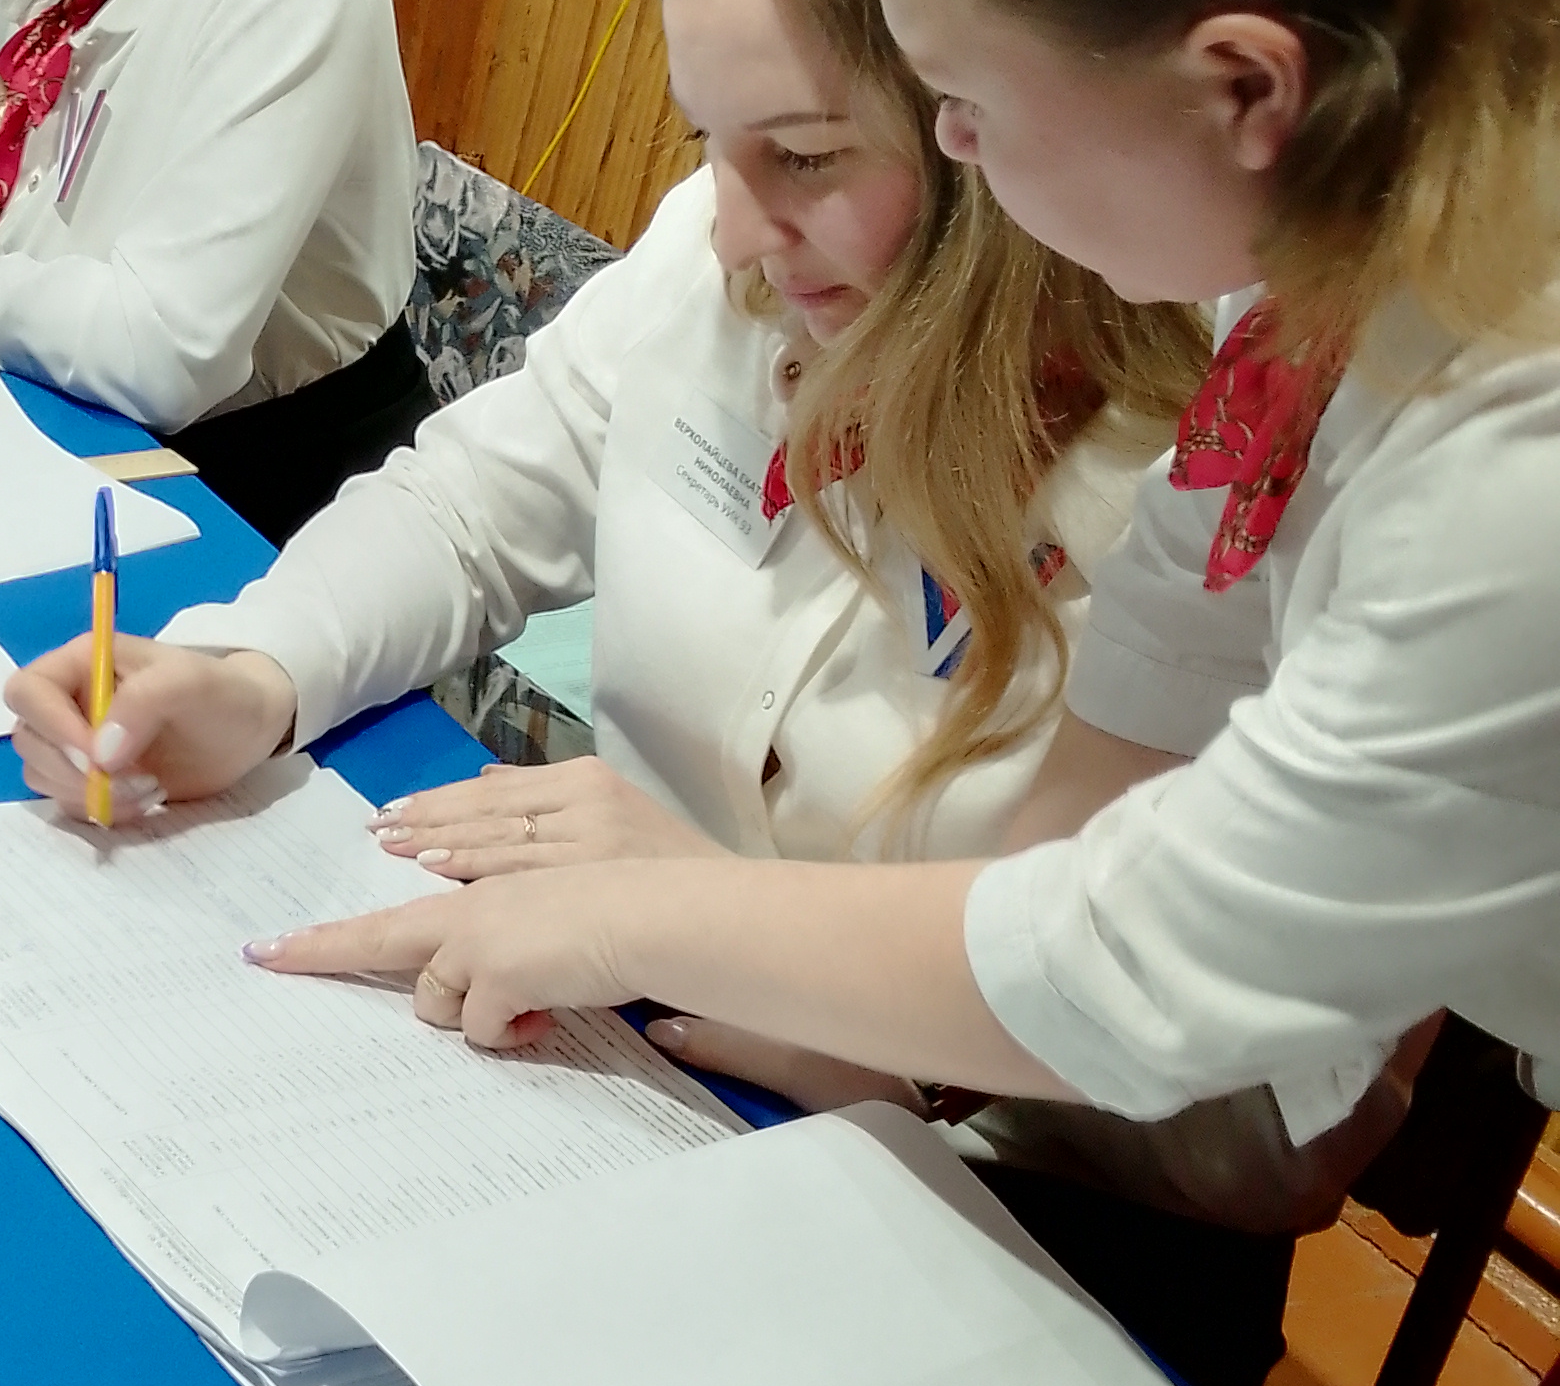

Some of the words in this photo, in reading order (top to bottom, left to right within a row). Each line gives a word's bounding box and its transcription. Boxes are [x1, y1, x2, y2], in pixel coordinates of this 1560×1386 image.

[673, 417, 739, 477] ВЕРХОЛАЙЦЕВА
[675, 464, 719, 508] Секретарь
[694, 456, 750, 510] НИКОЛАЕВНА
